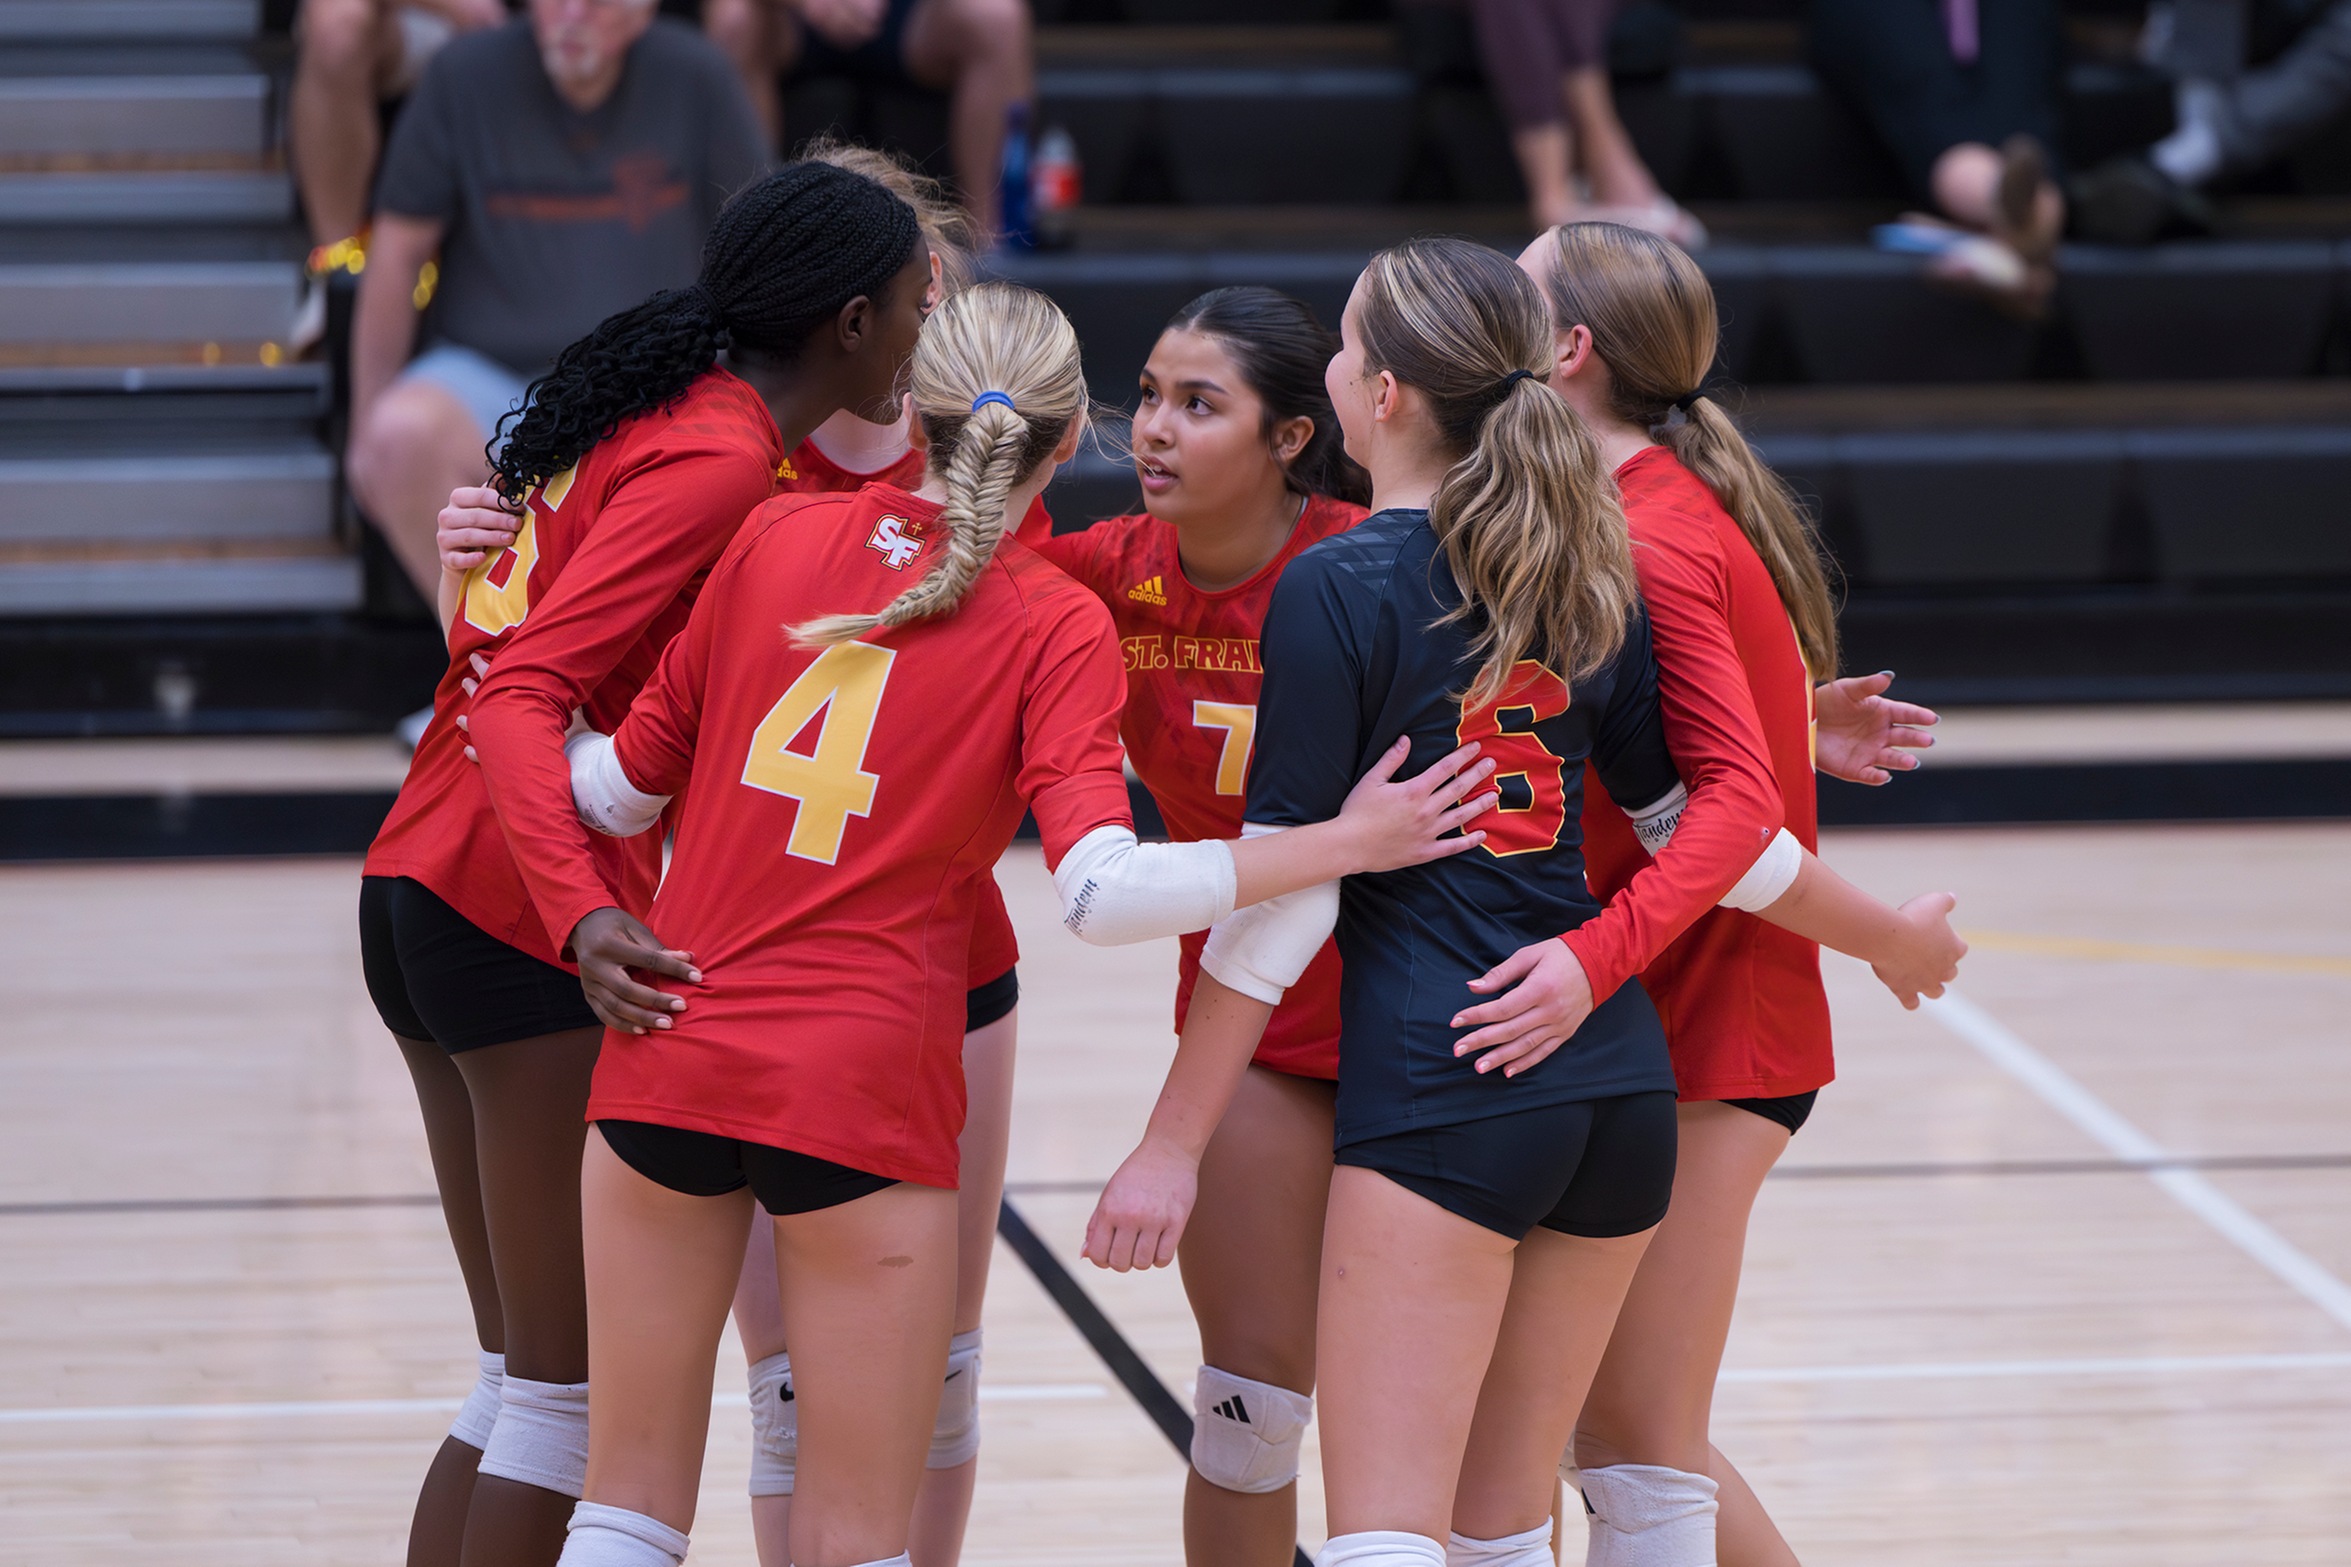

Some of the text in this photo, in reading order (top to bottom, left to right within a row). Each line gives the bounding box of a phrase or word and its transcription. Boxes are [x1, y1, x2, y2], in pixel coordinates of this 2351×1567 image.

[867, 515, 924, 569] SF
[1128, 589, 1167, 606] adidas
[740, 639, 898, 866] 4
[1193, 700, 1257, 796] 7
[1456, 659, 1571, 858] 6
[1064, 878, 1098, 937] Tandem
